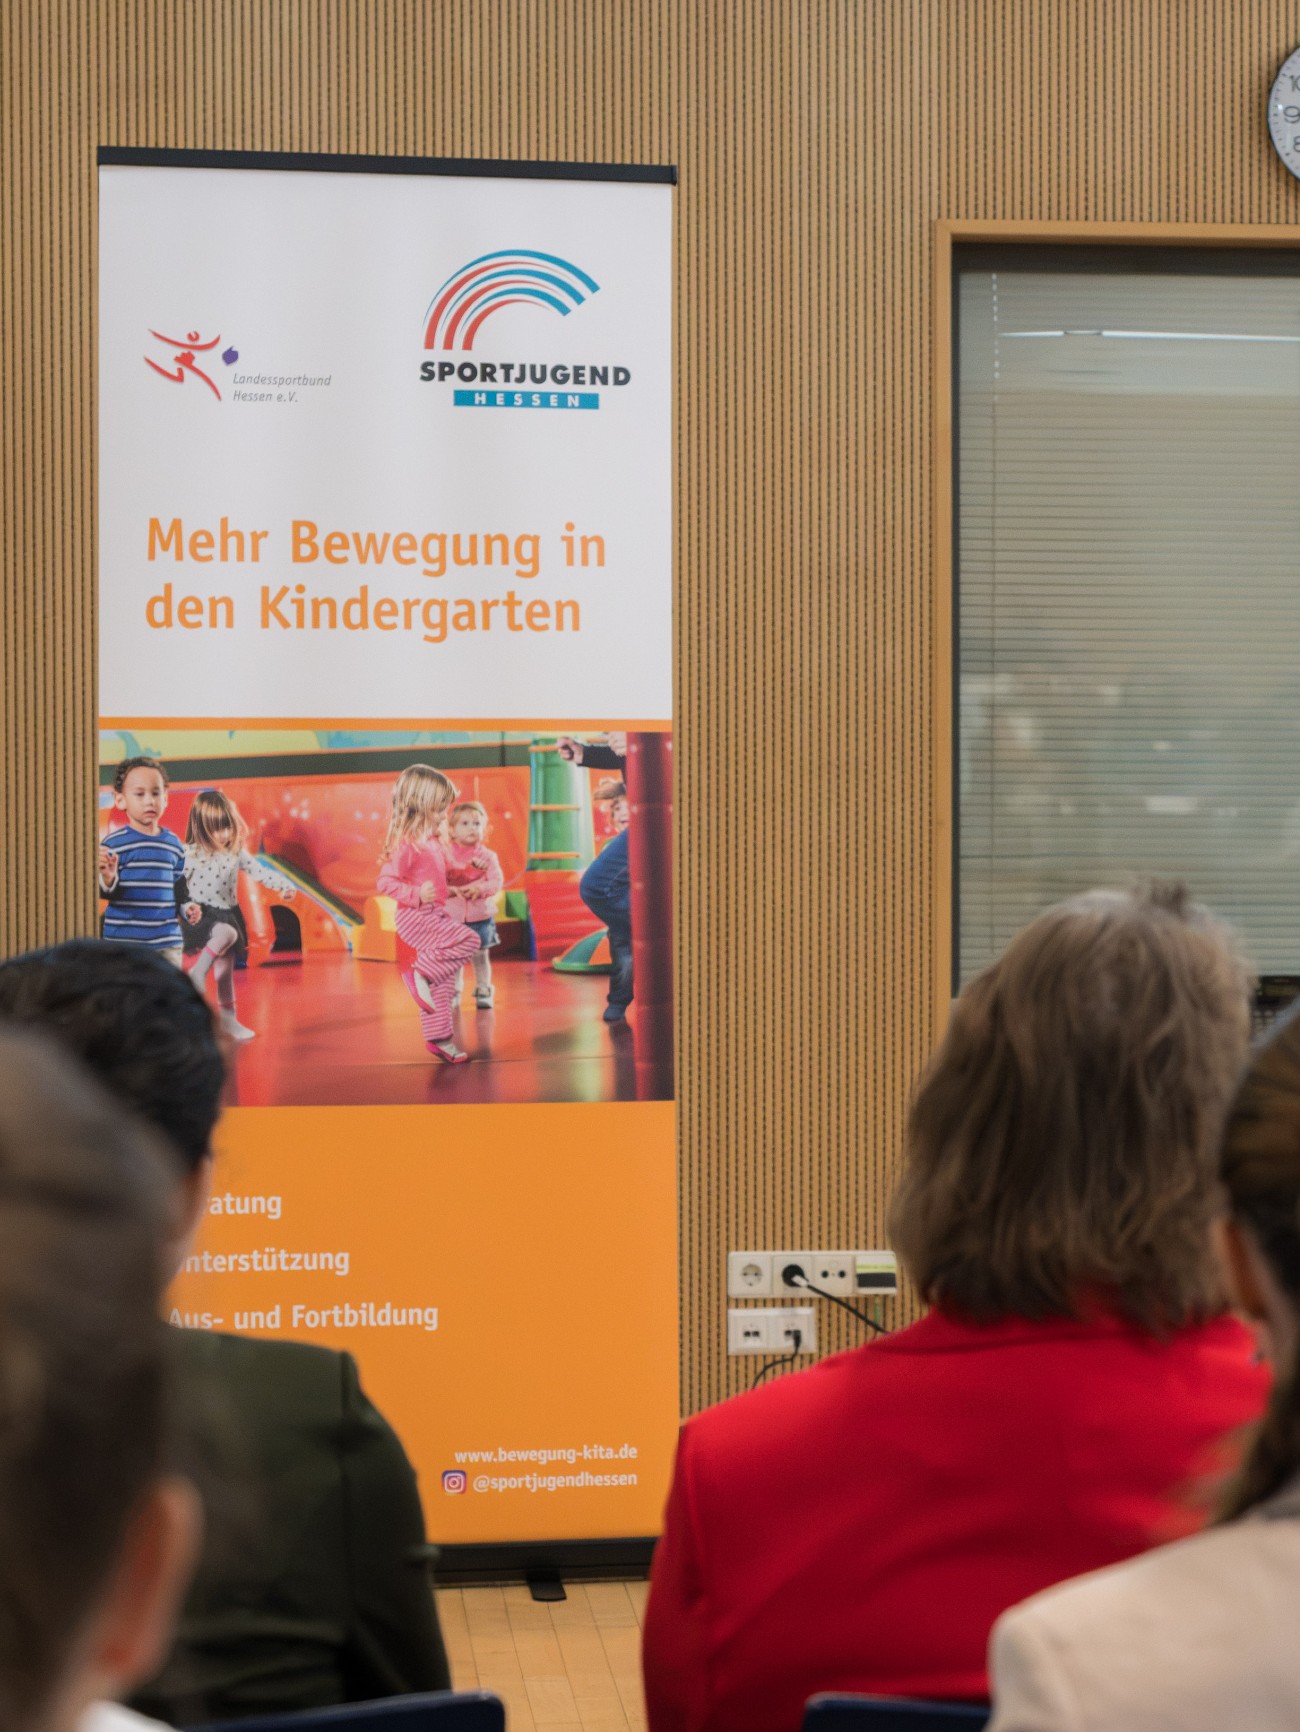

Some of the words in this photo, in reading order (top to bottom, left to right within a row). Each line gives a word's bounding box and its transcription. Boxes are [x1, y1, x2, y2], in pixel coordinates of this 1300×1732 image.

[1283, 105, 1300, 124] 9
[233, 373, 332, 387] Landessportbund
[420, 361, 631, 386] SPORTJUGEND
[233, 390, 272, 402] Hessen
[277, 391, 298, 402] e.V.
[474, 393, 580, 407] HESSEN
[147, 516, 268, 563] Mehr
[291, 519, 541, 578] Bewegung
[562, 521, 606, 567] in
[145, 583, 235, 629] den
[260, 584, 581, 643] Kindergarten
[209, 1192, 283, 1220] atung
[186, 1248, 350, 1275] nterstützung
[169, 1308, 224, 1329] Aus-
[234, 1304, 281, 1330] und
[292, 1302, 439, 1331] Fortbildung
[454, 1443, 638, 1465] www.bewegung-kita.de
[473, 1472, 638, 1493] @sportjugendhessen
